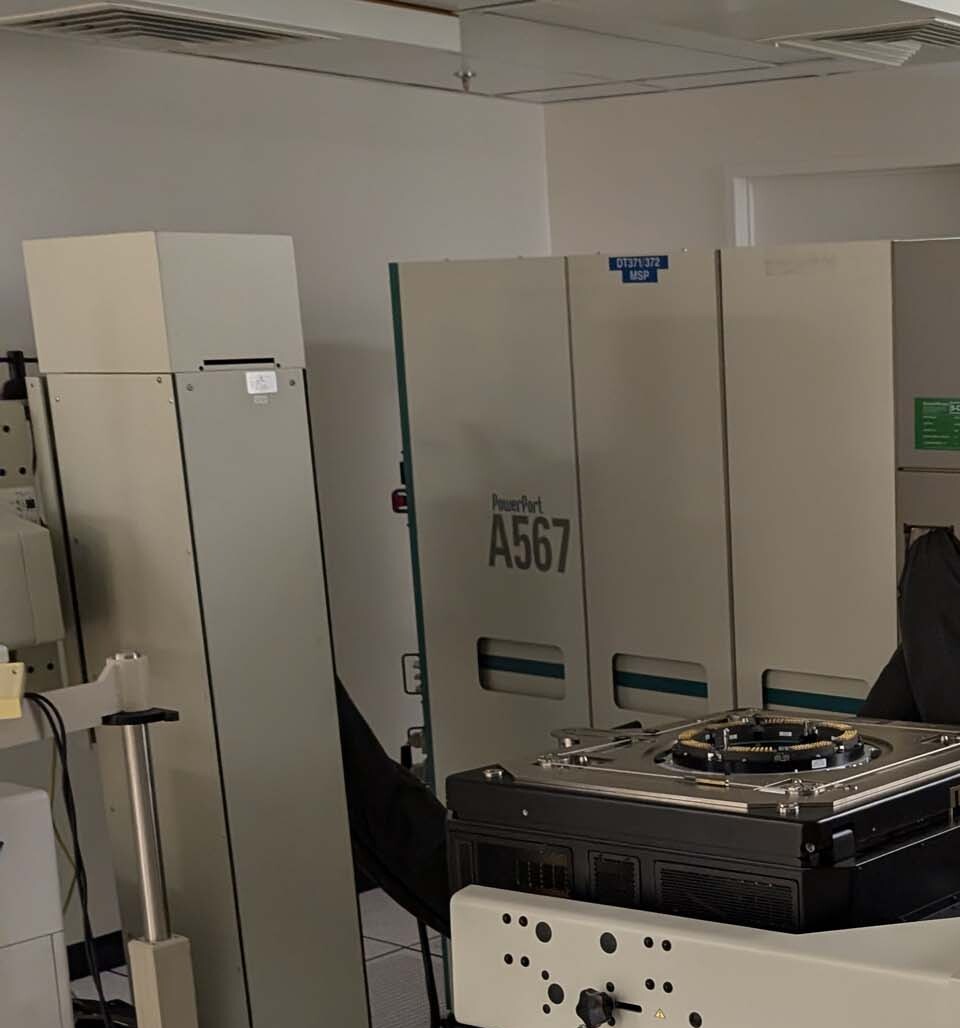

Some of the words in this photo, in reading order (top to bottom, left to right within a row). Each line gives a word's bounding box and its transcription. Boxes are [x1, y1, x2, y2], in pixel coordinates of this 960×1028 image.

[629, 270, 650, 281] MSP
[492, 492, 544, 514] PowerPort
[488, 513, 571, 574] A567
